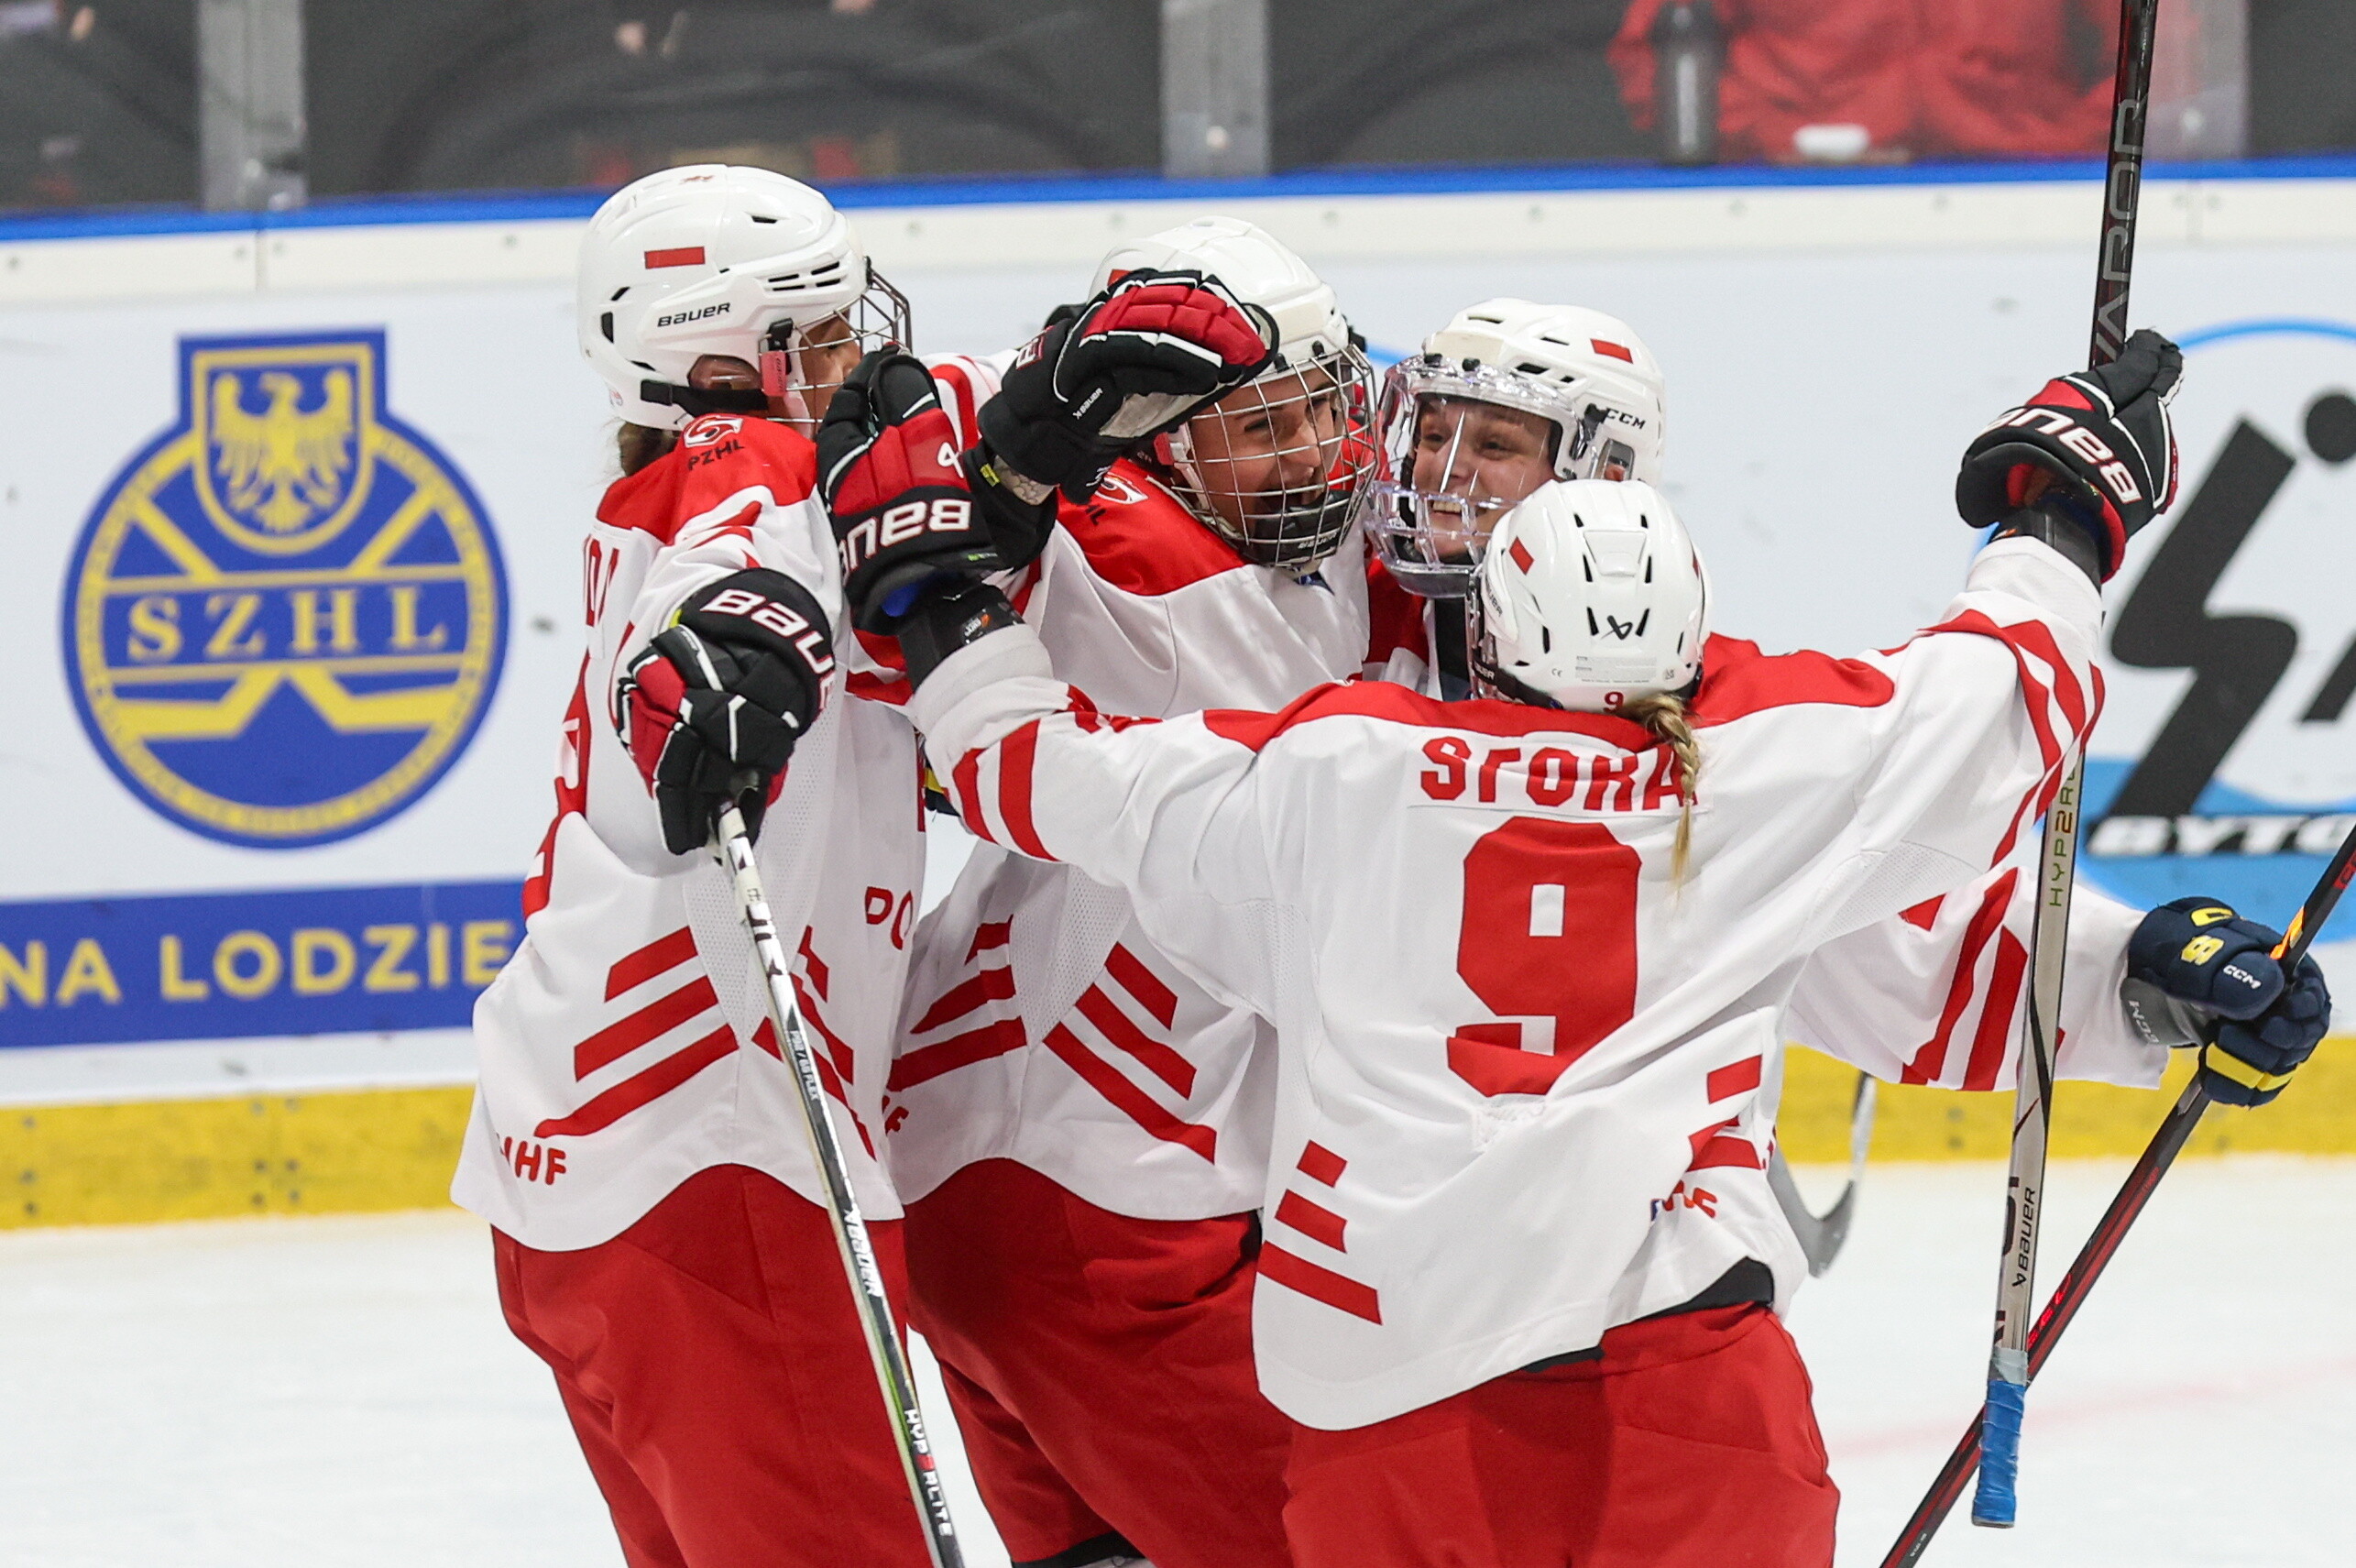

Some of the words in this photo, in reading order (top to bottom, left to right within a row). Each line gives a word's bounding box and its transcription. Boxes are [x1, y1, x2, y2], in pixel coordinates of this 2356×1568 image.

[657, 302, 730, 327] BAUER
[1605, 407, 1646, 430] CCM
[687, 440, 745, 471] PZHL
[126, 586, 447, 660] SZHL
[699, 589, 836, 709] BAU
[1605, 691, 1625, 712] 9
[0, 938, 122, 1006] NA
[159, 920, 513, 1001] LODZIE
[1446, 816, 1641, 1098] 9
[2223, 964, 2262, 989] CCM
[2018, 1189, 2035, 1271] BAUER
